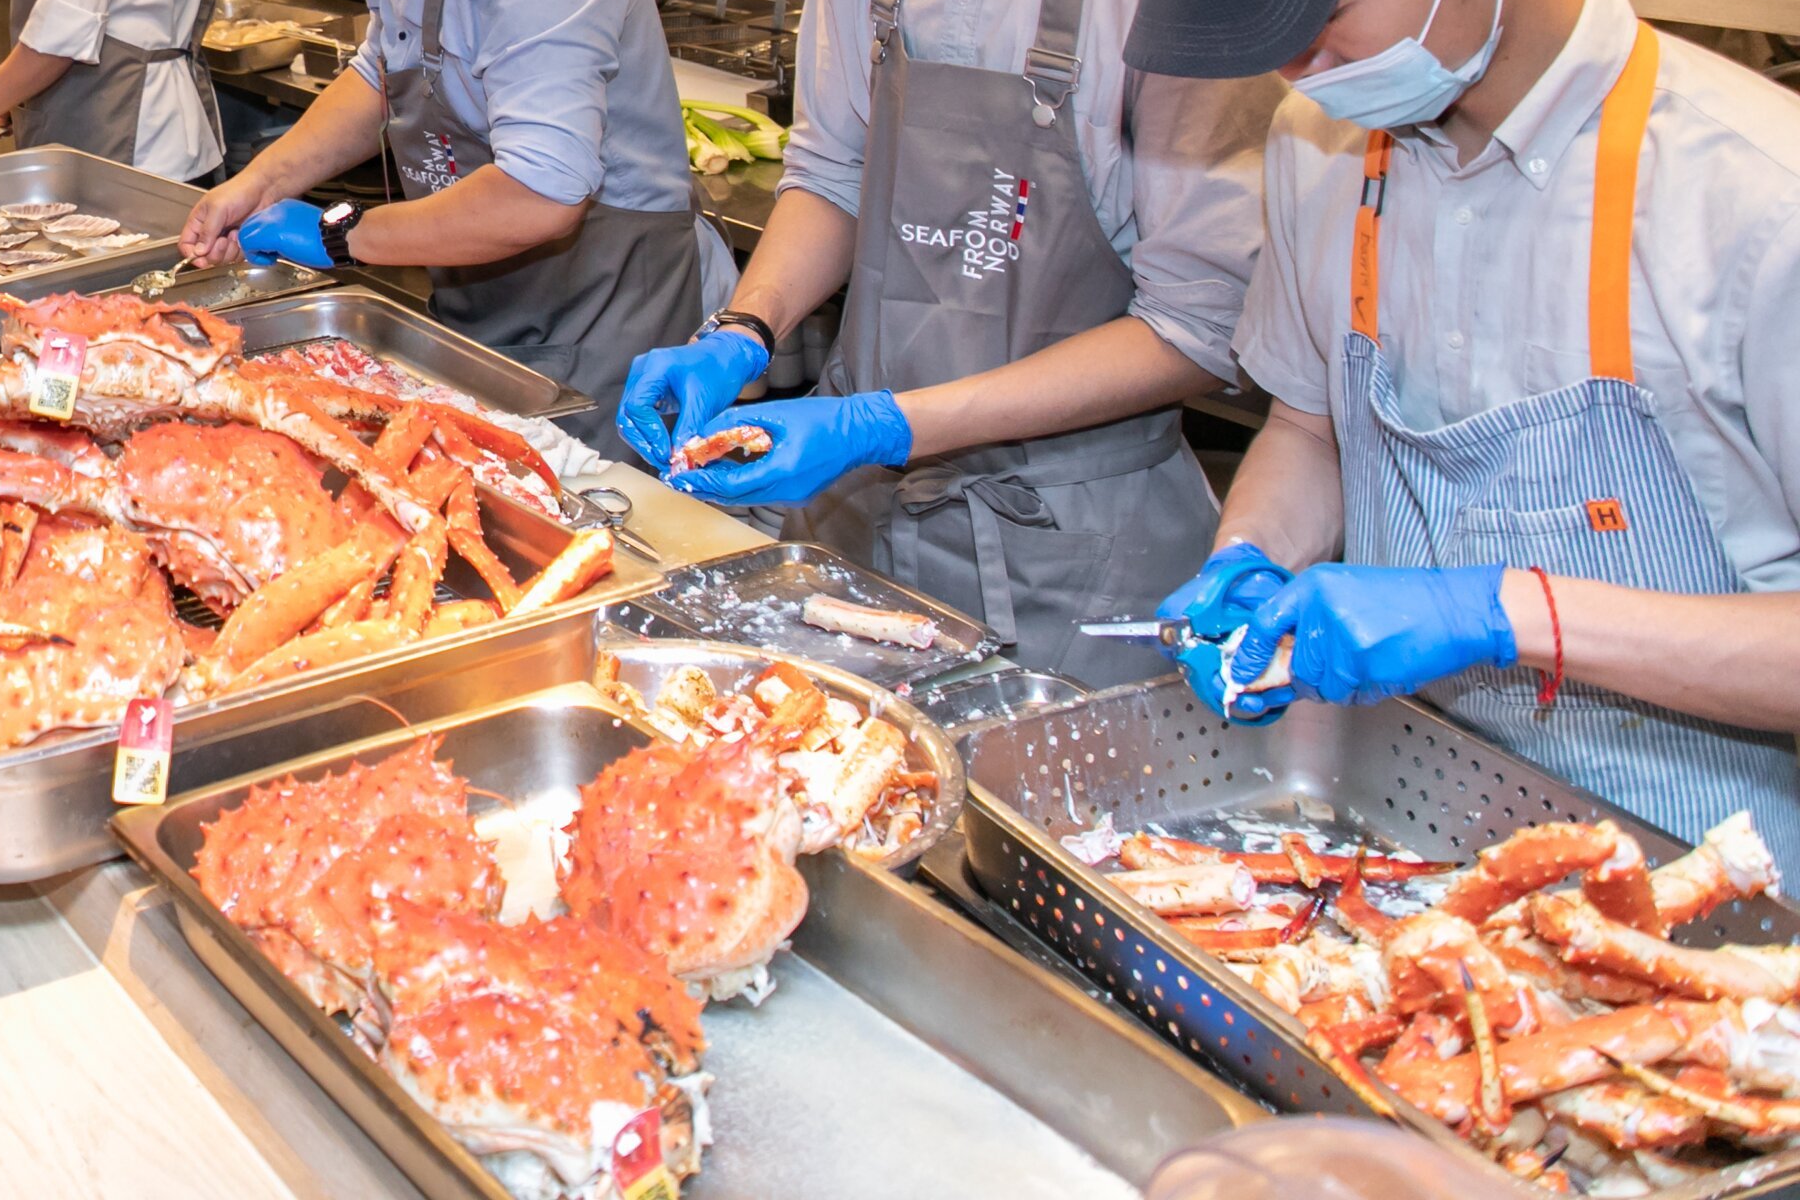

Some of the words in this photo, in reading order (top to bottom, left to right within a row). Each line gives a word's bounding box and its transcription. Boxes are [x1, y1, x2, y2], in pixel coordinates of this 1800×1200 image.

[422, 159, 442, 193] ROM
[423, 131, 452, 187] ORWAY
[901, 223, 1020, 261] SEAFOOD
[983, 167, 1015, 273] NORWAY
[962, 210, 989, 280] FROM
[1596, 507, 1618, 526] H
